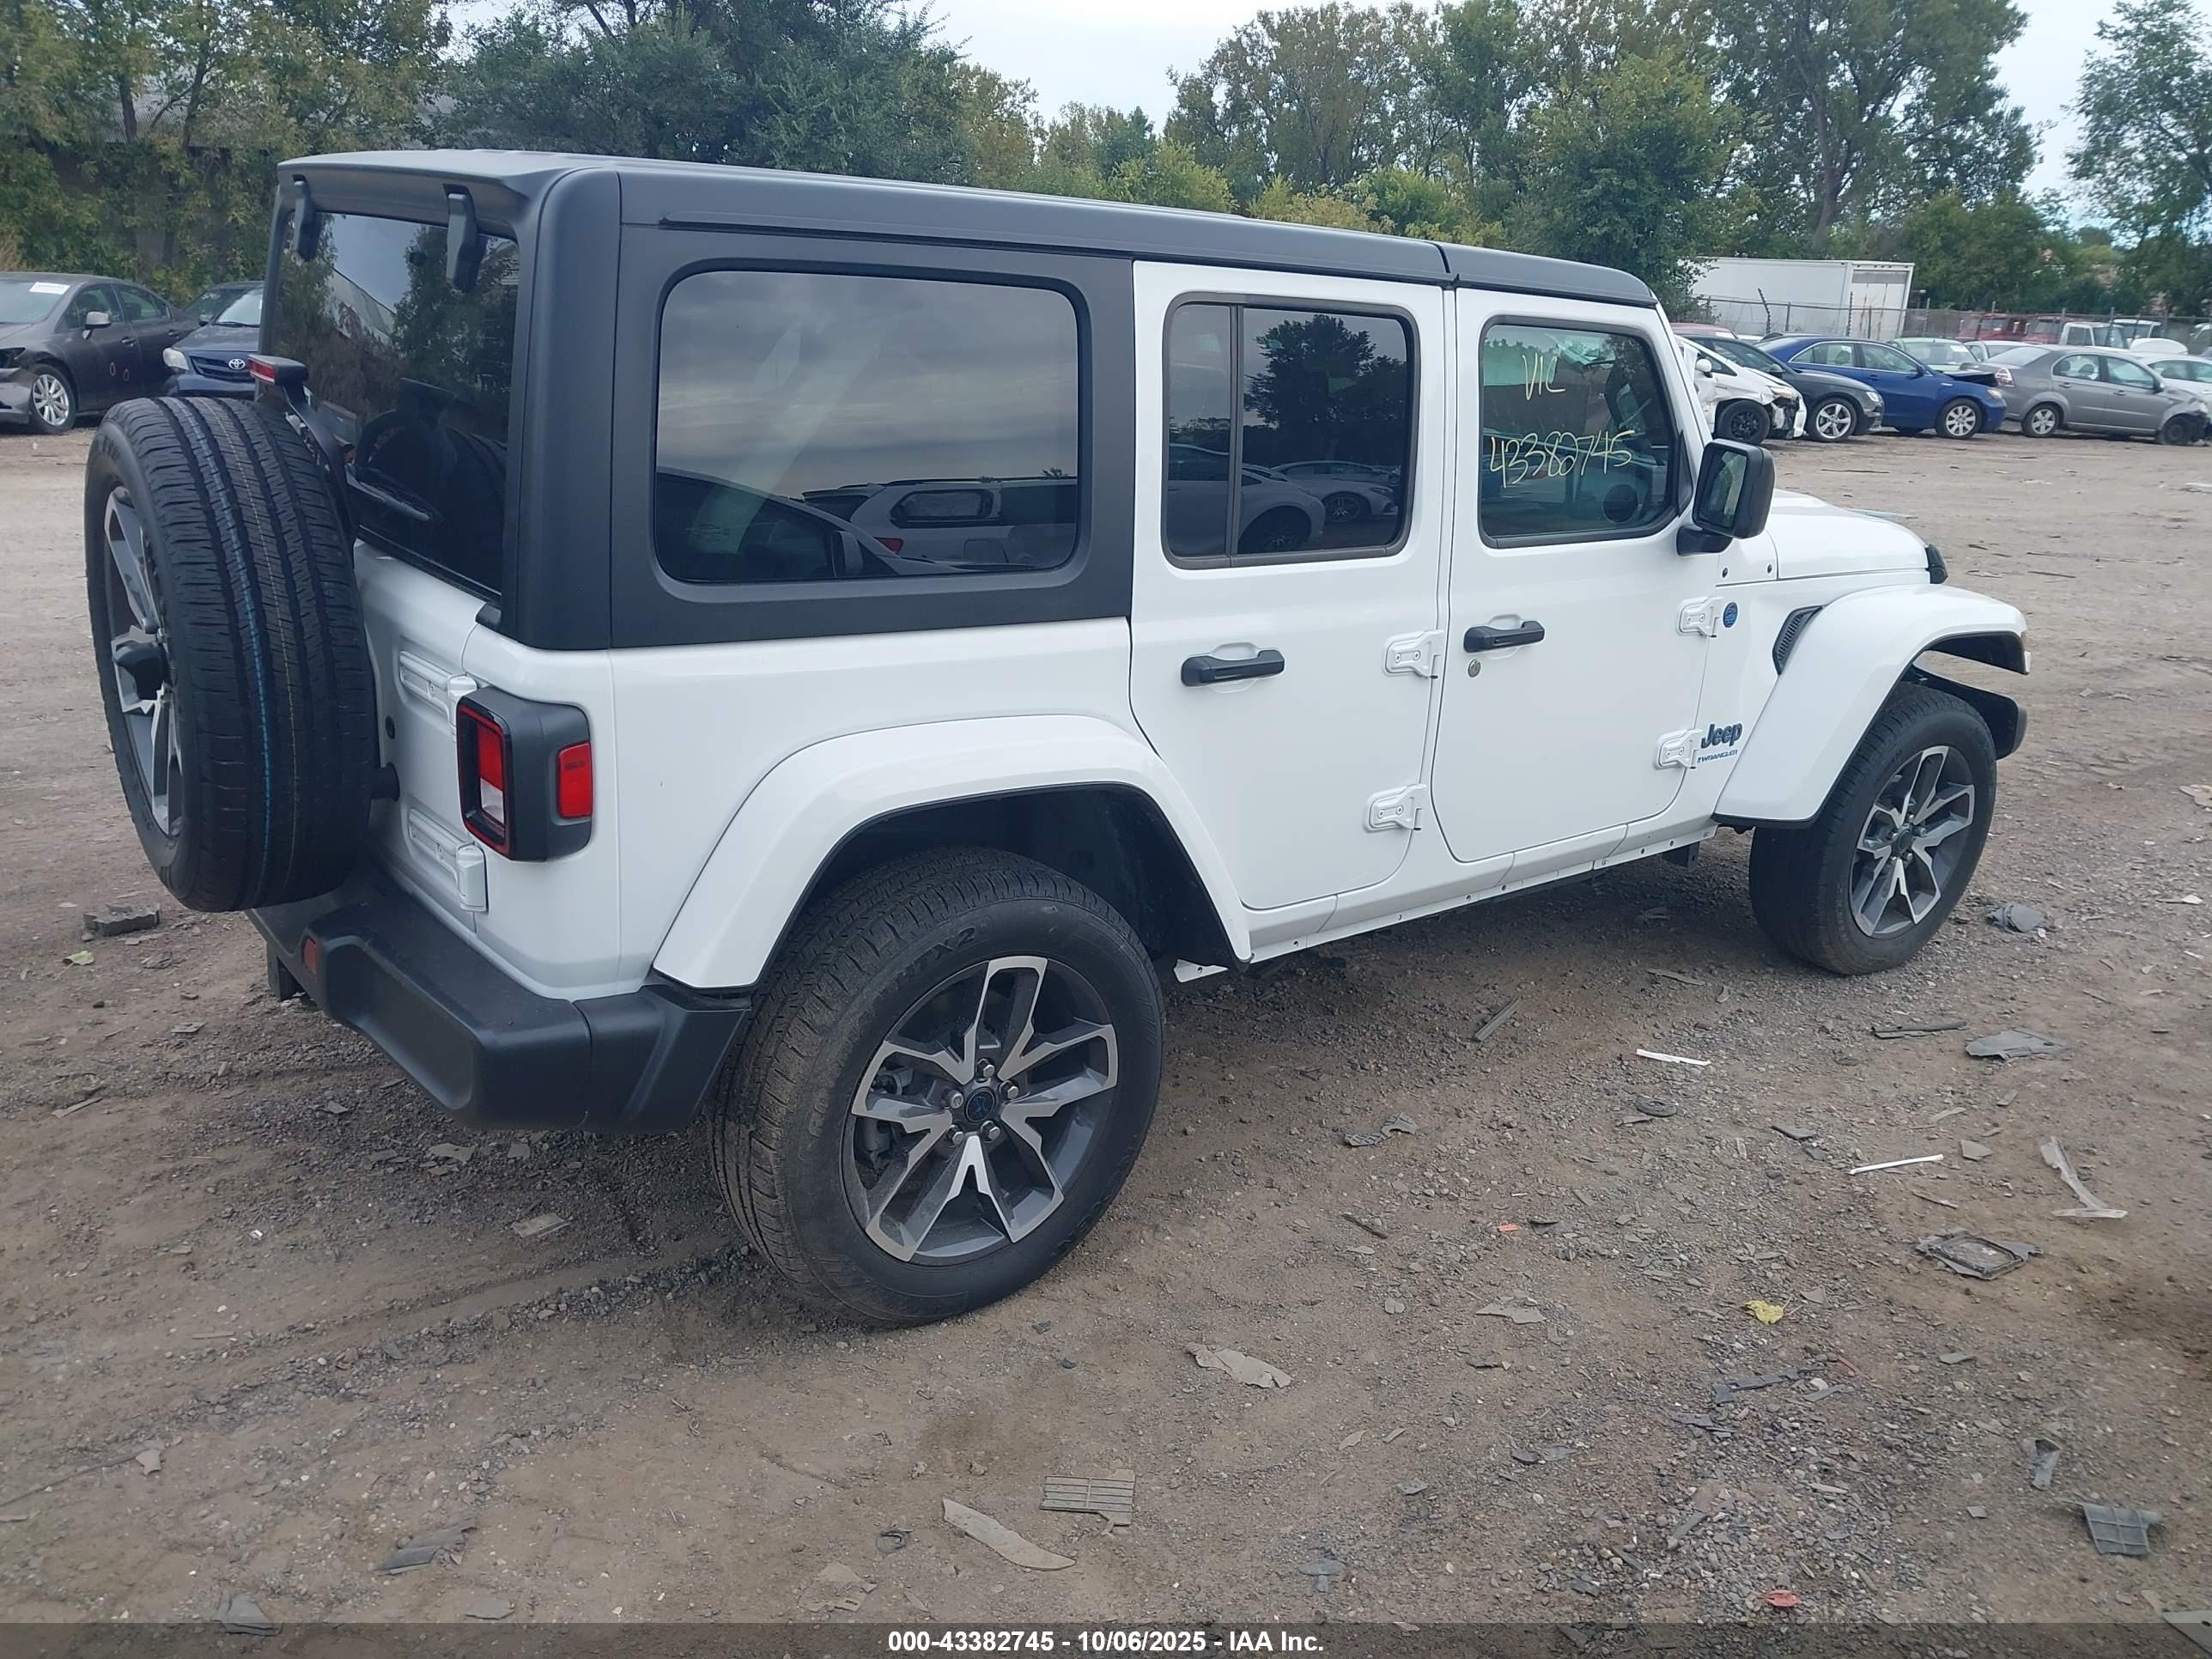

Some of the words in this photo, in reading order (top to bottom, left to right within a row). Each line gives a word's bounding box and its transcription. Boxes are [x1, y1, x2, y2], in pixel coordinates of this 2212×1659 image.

[1490, 430, 1635, 488] 43382745
[1700, 722, 1743, 749] Jeep
[1701, 749, 1738, 763] WRANGLER
